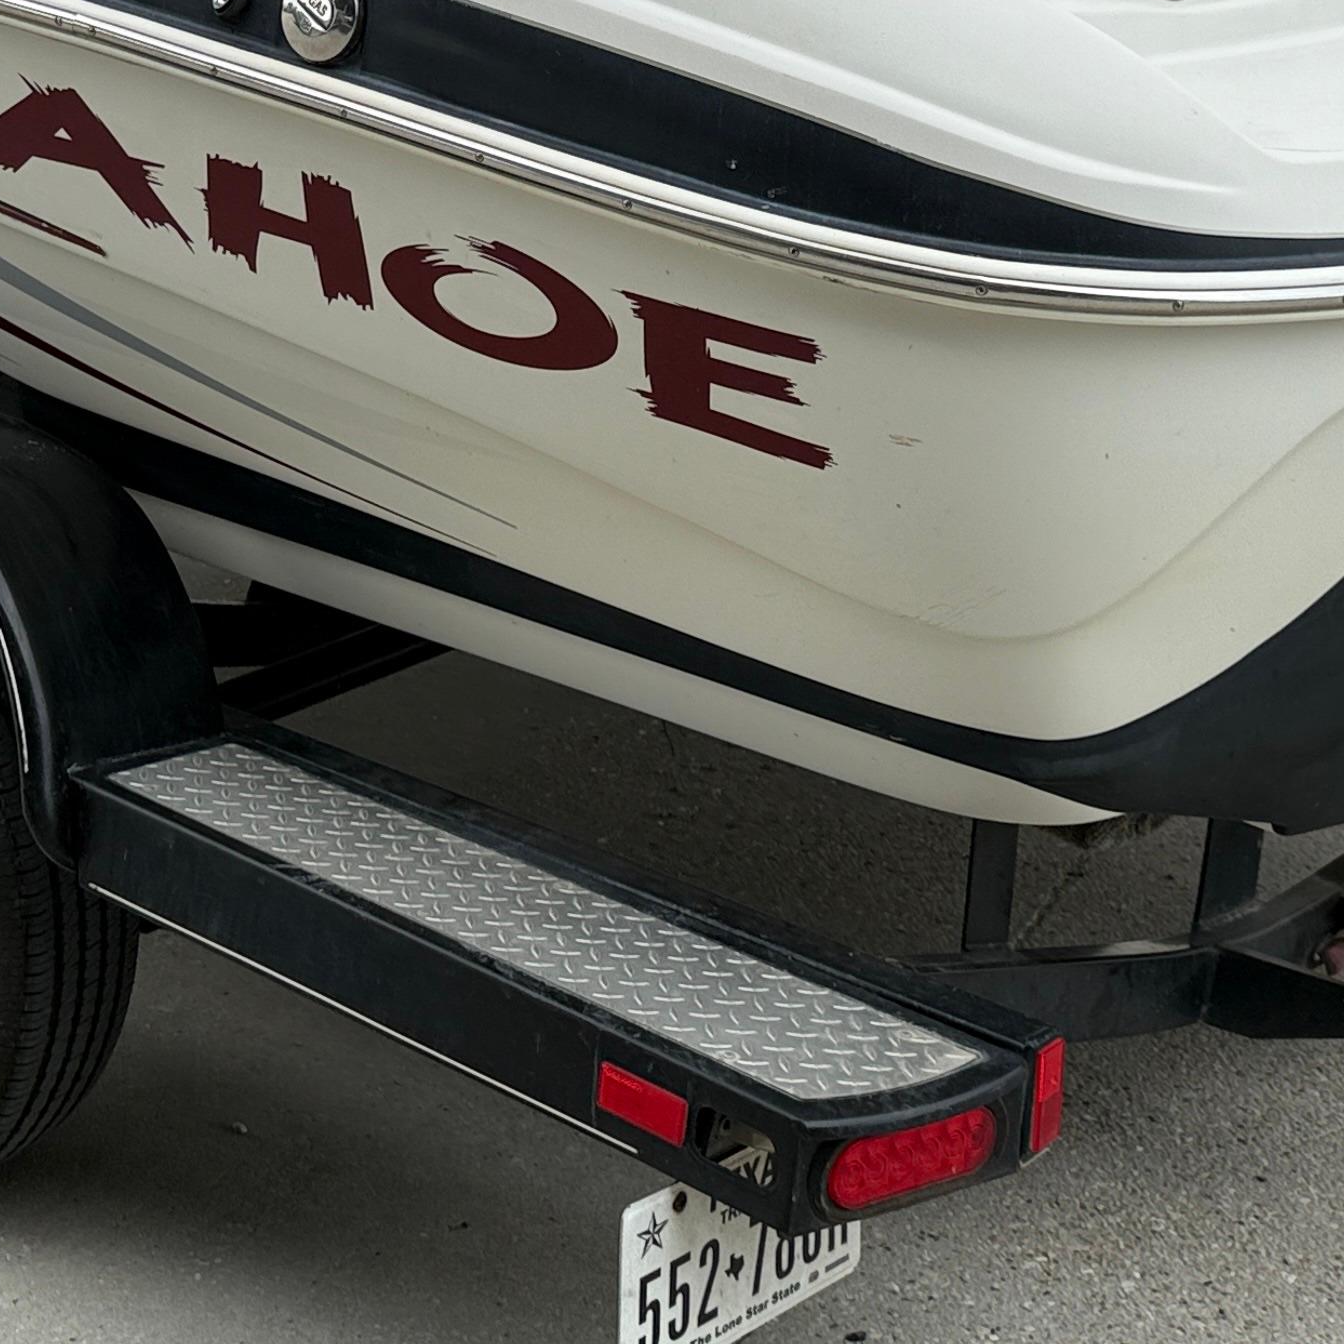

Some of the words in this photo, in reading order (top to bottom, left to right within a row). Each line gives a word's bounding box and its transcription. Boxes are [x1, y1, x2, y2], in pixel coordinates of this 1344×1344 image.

[638, 1238, 721, 1344] 552
[714, 1315, 743, 1338] Lone
[745, 1299, 770, 1320] Star
[771, 1281, 801, 1305] State
